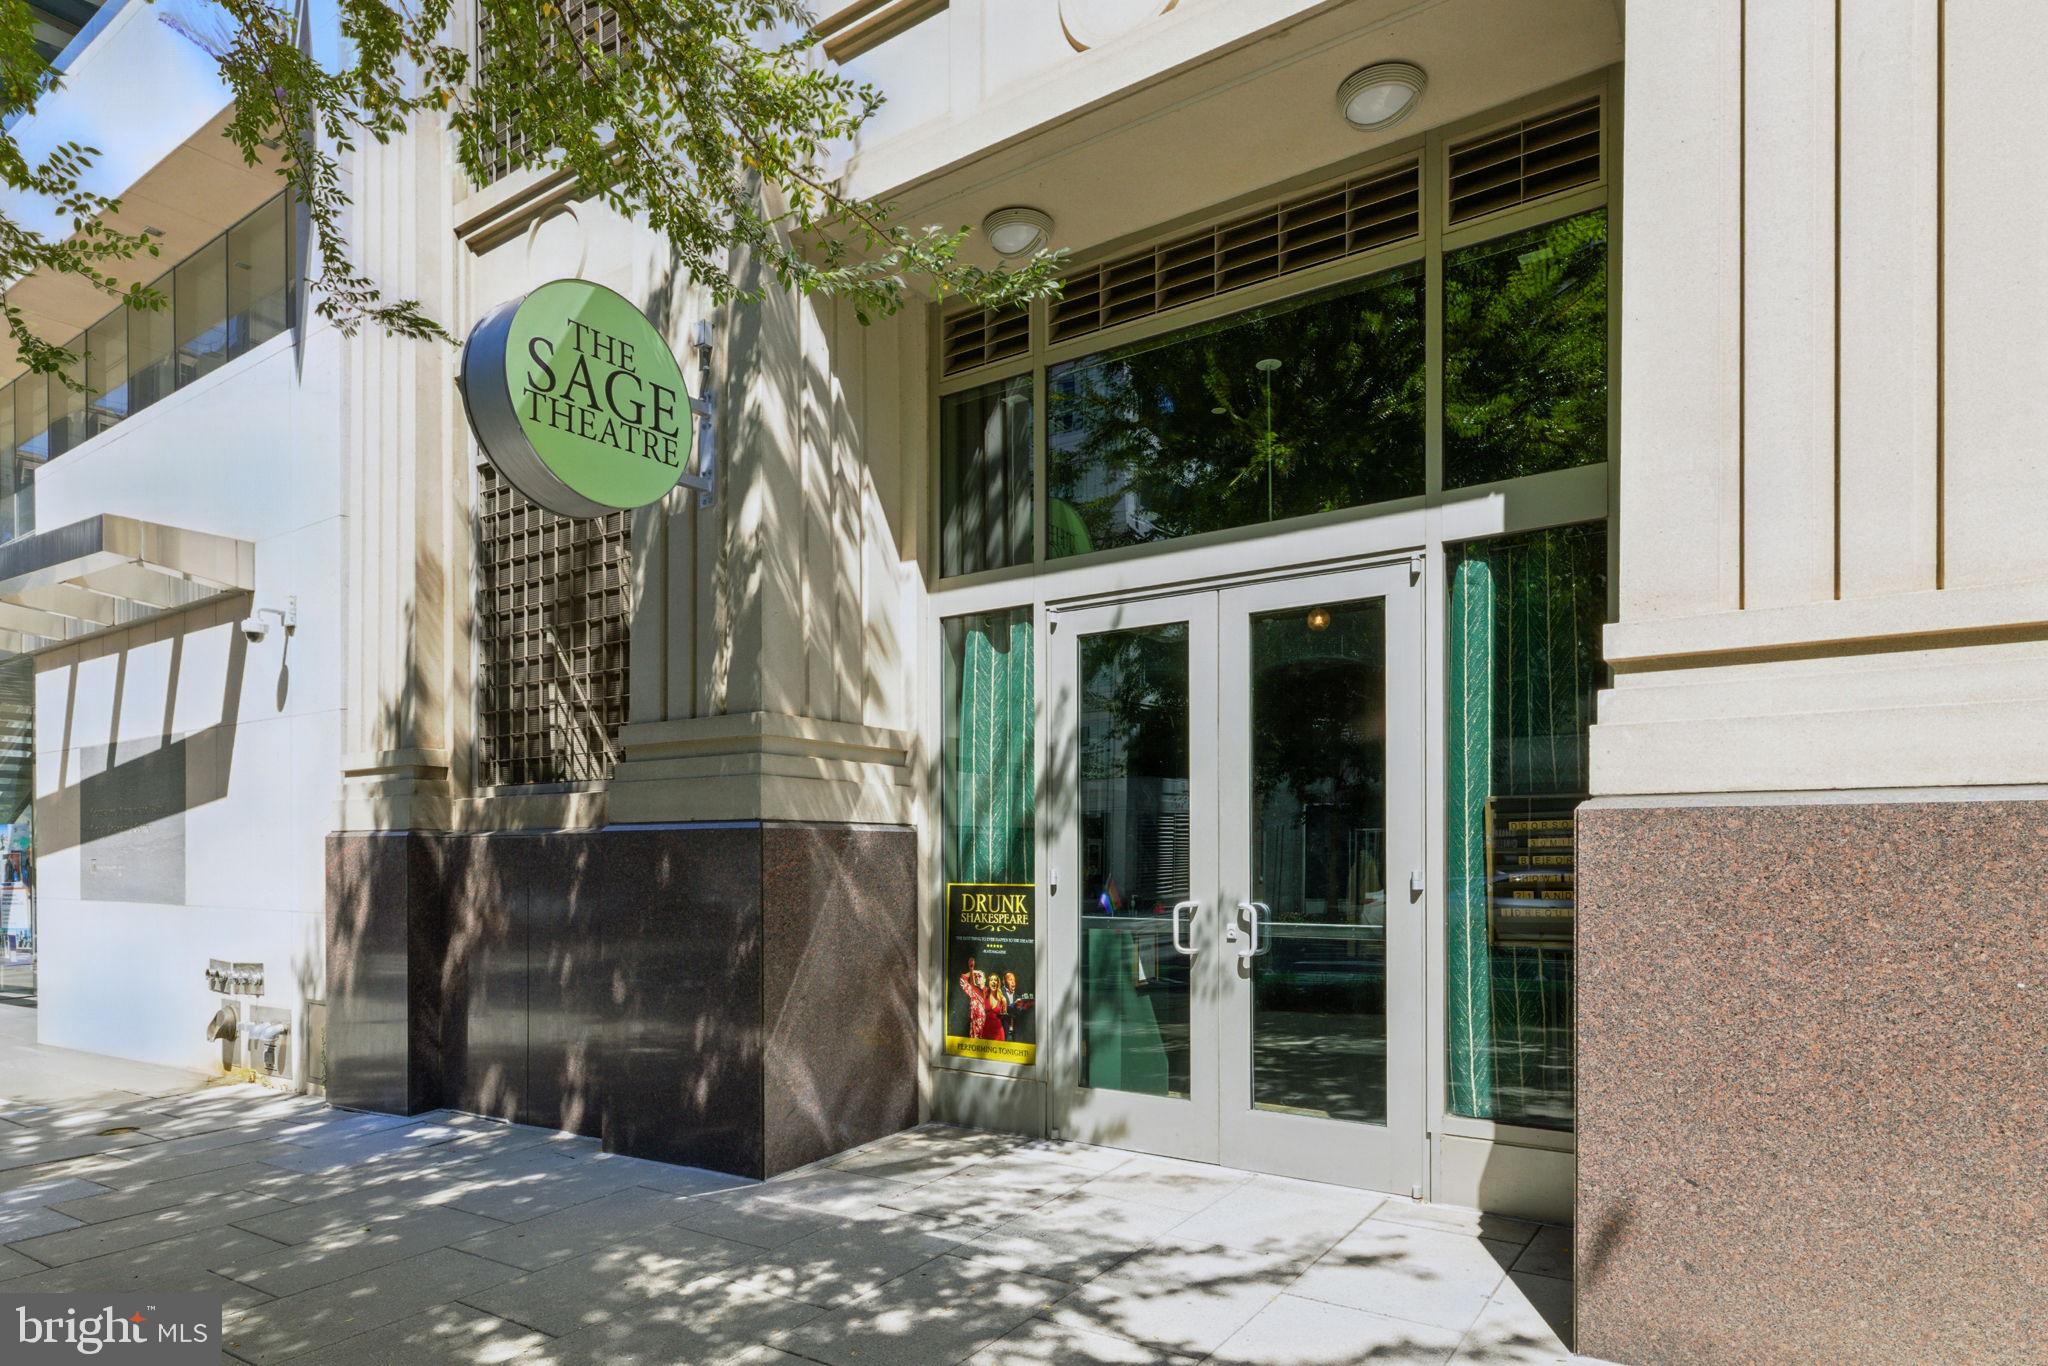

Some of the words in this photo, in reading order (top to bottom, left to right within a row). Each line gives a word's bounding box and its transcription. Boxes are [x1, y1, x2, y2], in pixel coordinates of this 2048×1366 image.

[567, 318, 636, 374] THE
[527, 336, 679, 439] SAGE
[523, 387, 679, 468] THEATRE
[961, 893, 1028, 914] DRUNK
[961, 913, 1029, 925] SHAKESPEARE
[957, 1043, 997, 1054] PERFORMING
